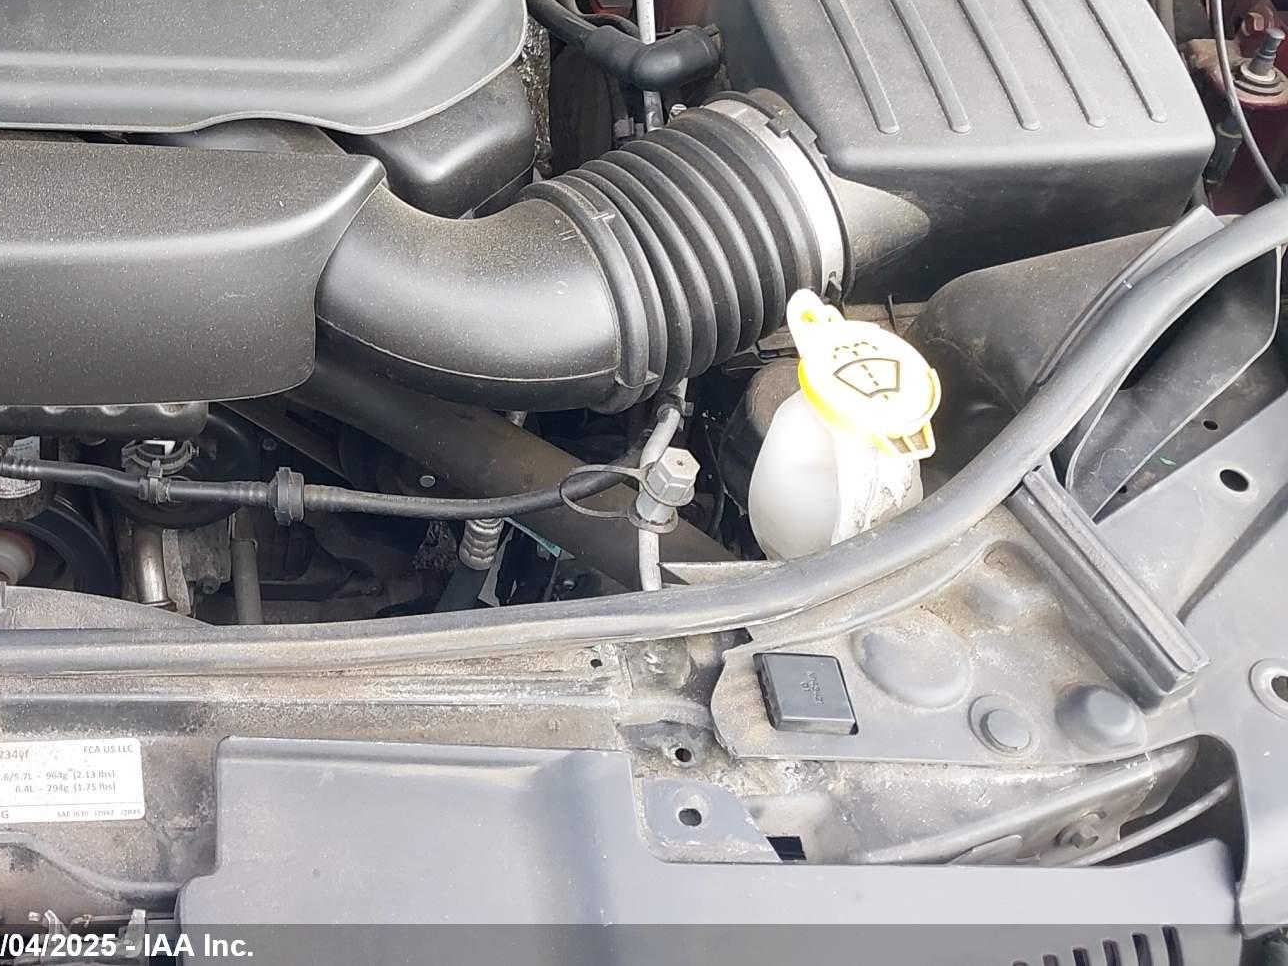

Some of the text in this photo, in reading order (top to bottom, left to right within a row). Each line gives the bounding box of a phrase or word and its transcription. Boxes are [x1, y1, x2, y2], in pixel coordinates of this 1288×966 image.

[83, 745, 134, 754] FCA US LLC
[46, 772, 69, 781] 964g
[73, 771, 96, 780] (2.13
[98, 770, 115, 779] lbs)
[47, 784, 69, 794] 794g
[73, 783, 97, 793] (1.75
[99, 782, 116, 792] lbs)
